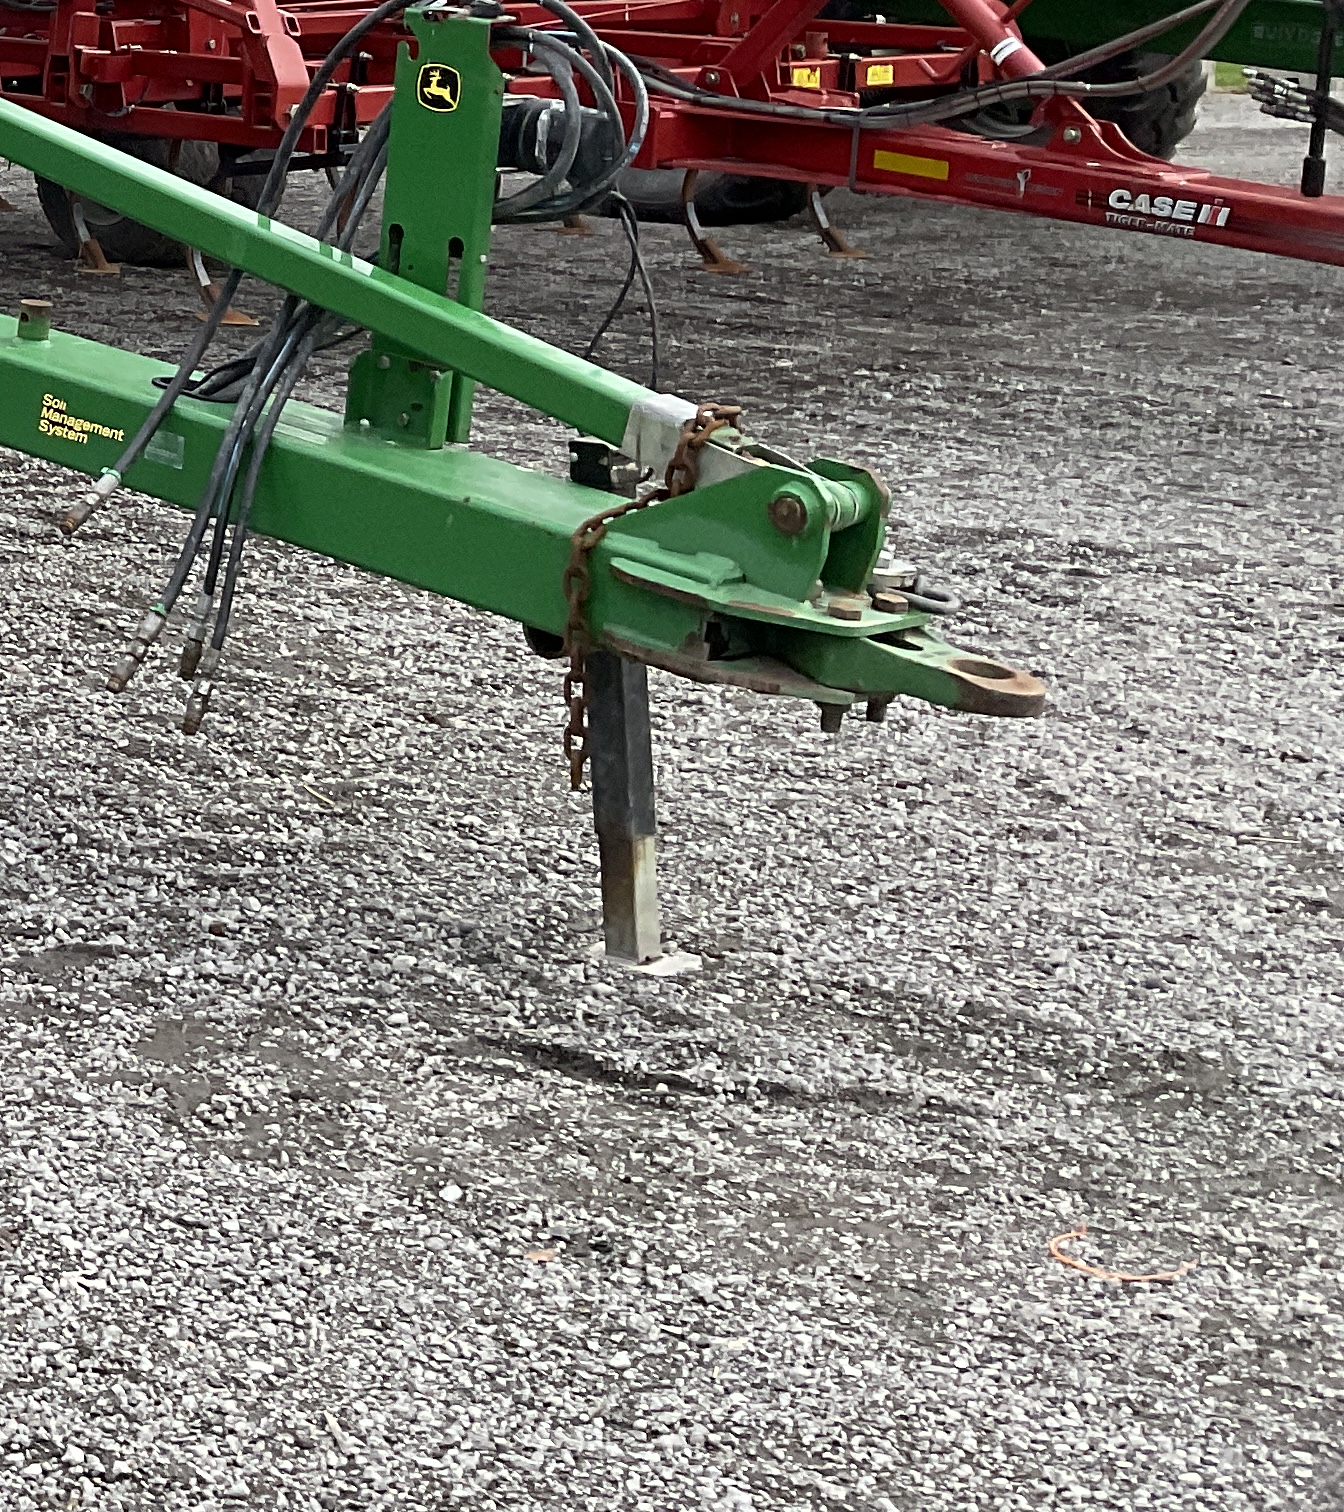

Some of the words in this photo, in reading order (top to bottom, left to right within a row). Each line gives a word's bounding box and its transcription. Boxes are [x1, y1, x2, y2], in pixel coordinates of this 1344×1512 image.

[1109, 189, 1198, 221] CASE
[42, 393, 67, 411] Soil
[38, 419, 88, 444] System
[40, 406, 125, 442] Management
